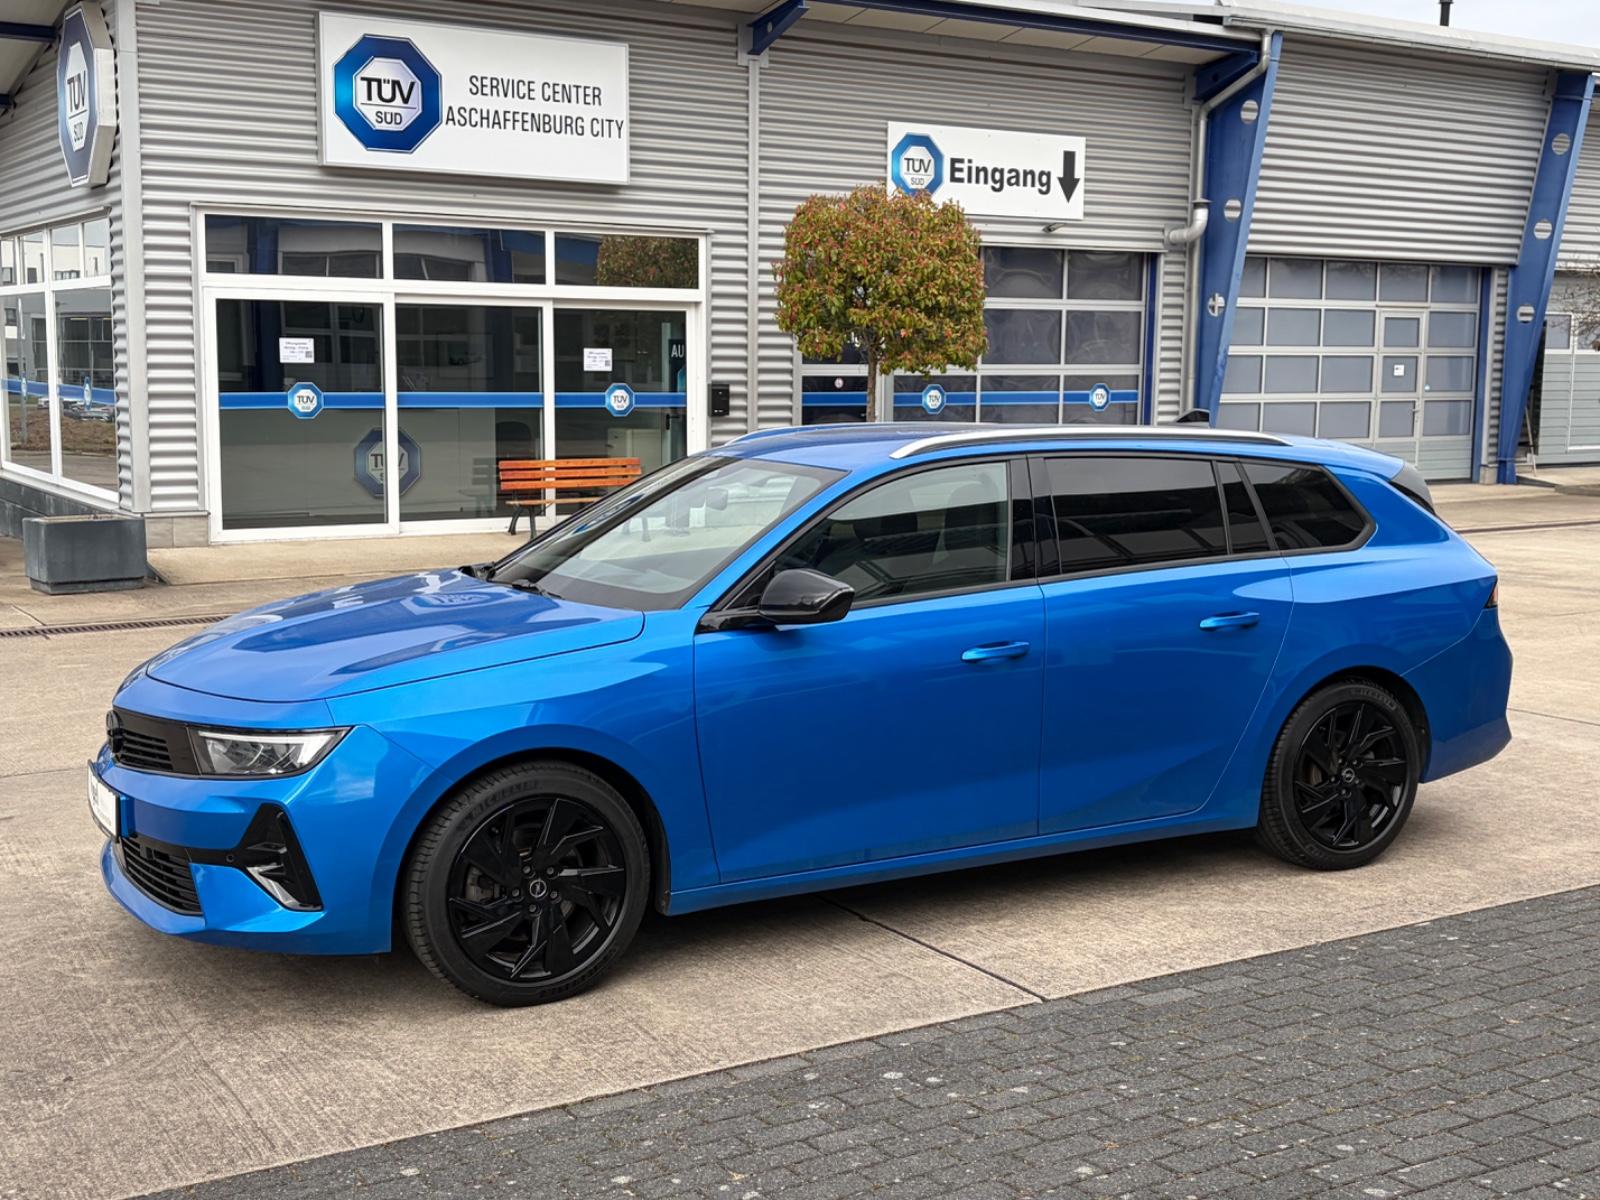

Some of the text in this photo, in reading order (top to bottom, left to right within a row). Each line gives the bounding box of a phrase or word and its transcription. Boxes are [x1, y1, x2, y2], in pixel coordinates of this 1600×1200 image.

[360, 76, 416, 105] TÜV
[468, 75, 602, 106] SERVICE CENTER
[375, 110, 403, 126] SÜD
[445, 105, 625, 139] ASCHAFFENBURG CITY
[904, 157, 932, 174] TÜV
[949, 157, 1052, 196] Eingang
